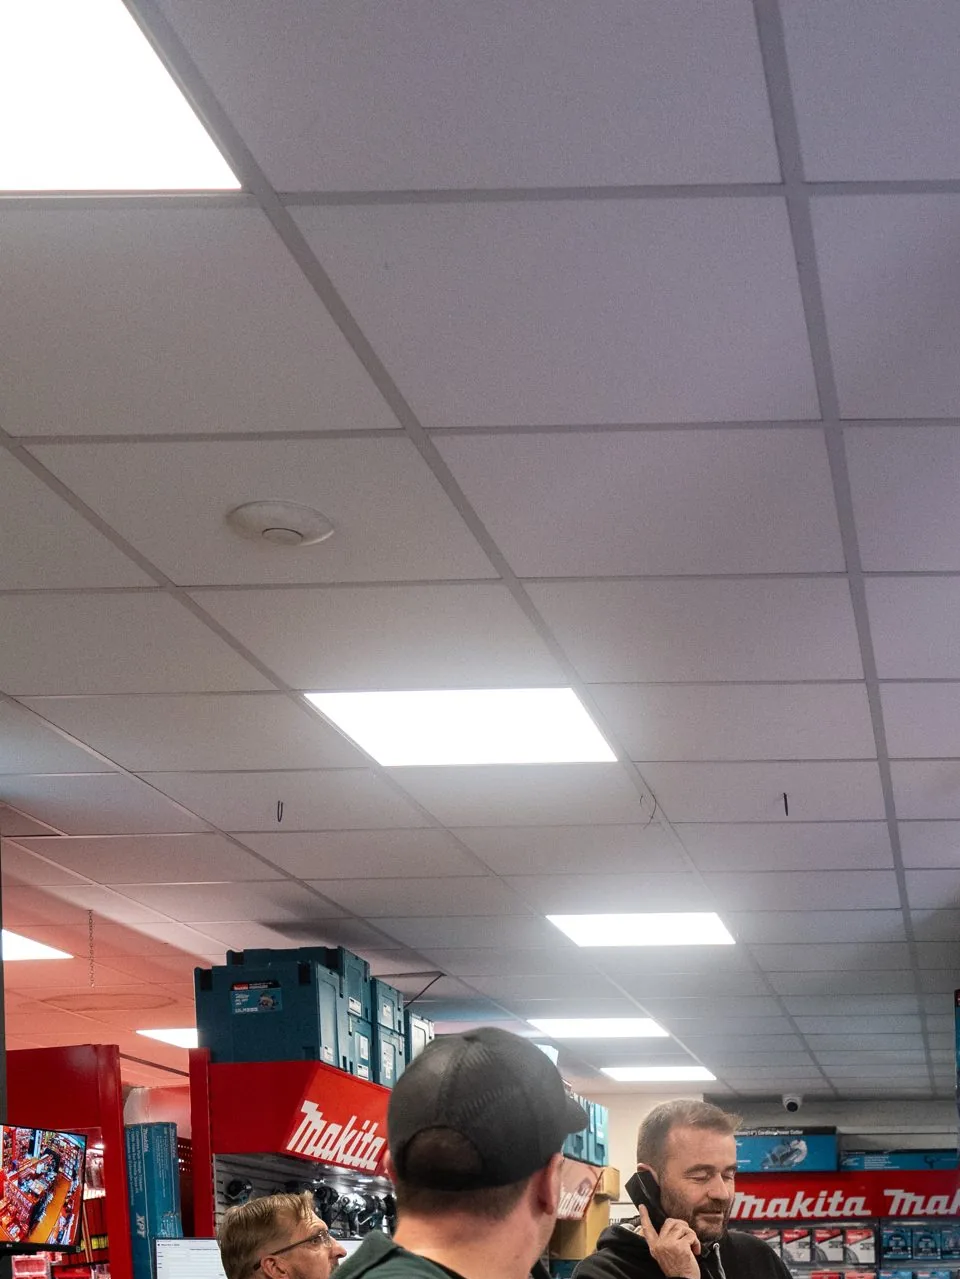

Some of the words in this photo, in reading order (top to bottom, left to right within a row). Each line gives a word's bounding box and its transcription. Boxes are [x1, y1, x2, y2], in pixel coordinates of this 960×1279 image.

[286, 1100, 386, 1171] Makita
[729, 1190, 871, 1219] Makita
[136, 1212, 147, 1239] XPT
